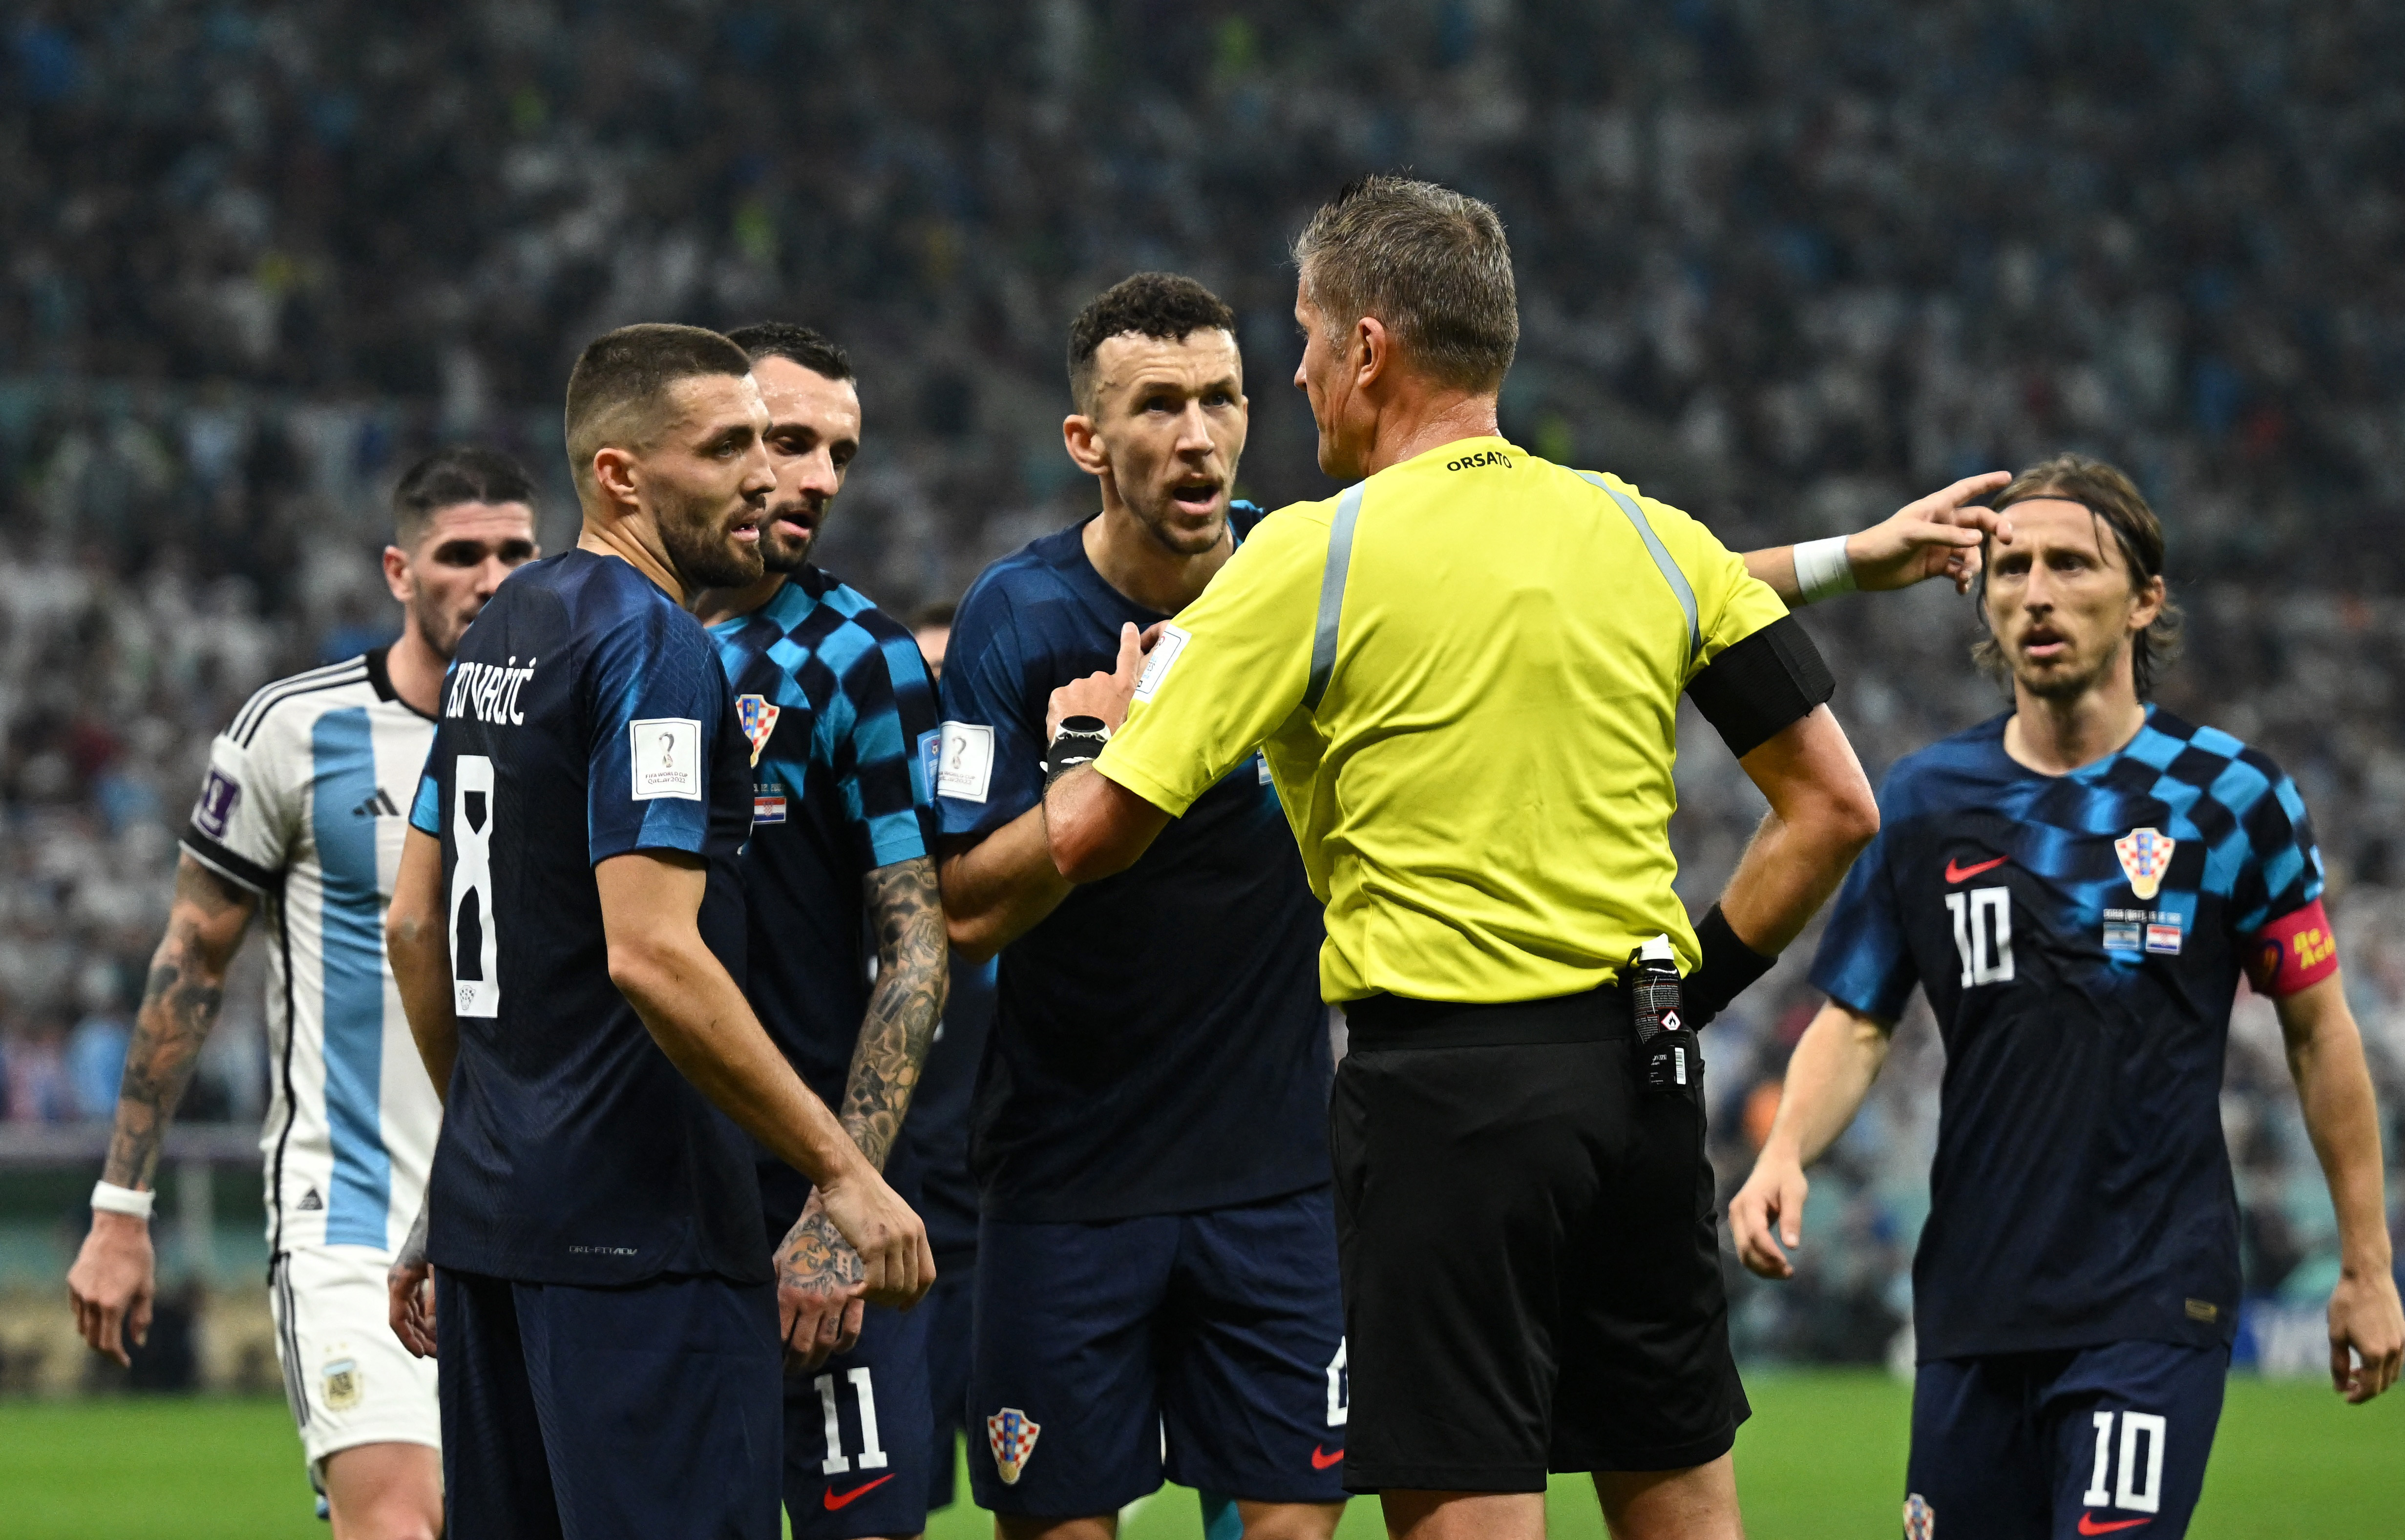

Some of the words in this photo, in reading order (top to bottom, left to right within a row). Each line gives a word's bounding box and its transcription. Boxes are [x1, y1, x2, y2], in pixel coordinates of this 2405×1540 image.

[1447, 451, 1512, 471] ORSATO
[449, 755, 500, 1018] 8
[1944, 886, 2015, 989] 10
[814, 1367, 888, 1476] 11
[2083, 1410, 2167, 1514] 10
